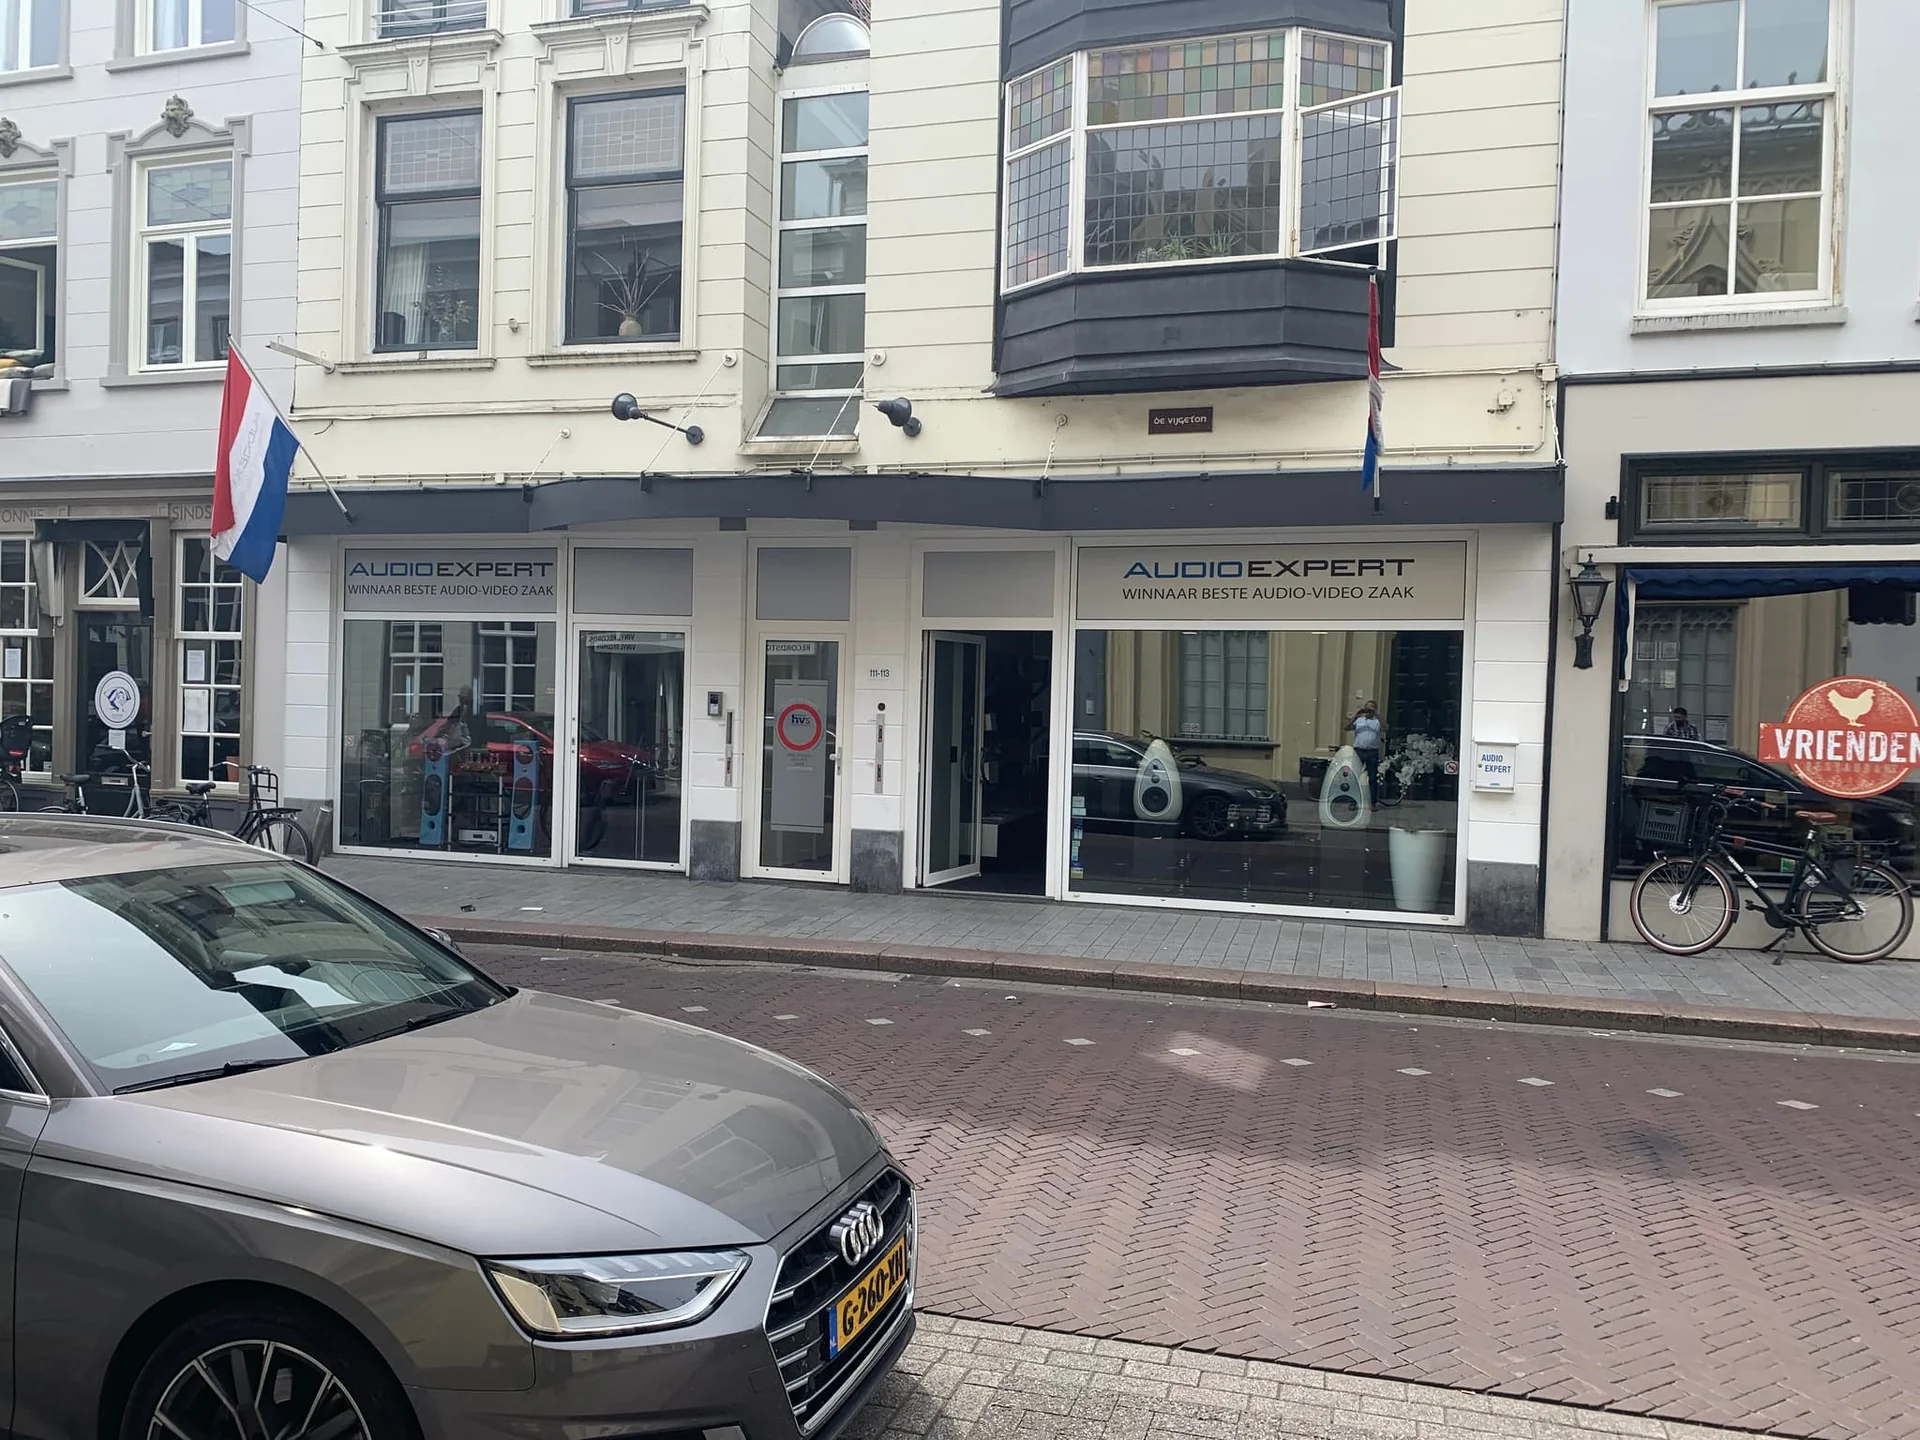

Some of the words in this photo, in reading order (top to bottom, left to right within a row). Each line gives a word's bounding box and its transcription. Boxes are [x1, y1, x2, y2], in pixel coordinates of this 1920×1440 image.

[349, 562, 554, 577] AUDIOEXPERT
[1123, 559, 1415, 578] AUDIOEXPERT
[347, 584, 402, 595] WINNAAR
[404, 585, 437, 595] BESTE
[440, 584, 519, 596] AUDIO-VIDEO
[521, 585, 554, 596] ZAAK
[1122, 587, 1197, 600] WINNAAR
[1202, 587, 1248, 600] BESTE
[1252, 586, 1363, 599] AUDIO-VIDEO
[1368, 586, 1415, 599] ZAAK
[869, 668, 890, 678] 111-113
[1481, 753, 1504, 763] AUDIO
[1484, 764, 1512, 773] EXPERT
[842, 1244, 903, 1337] G-260-XH
